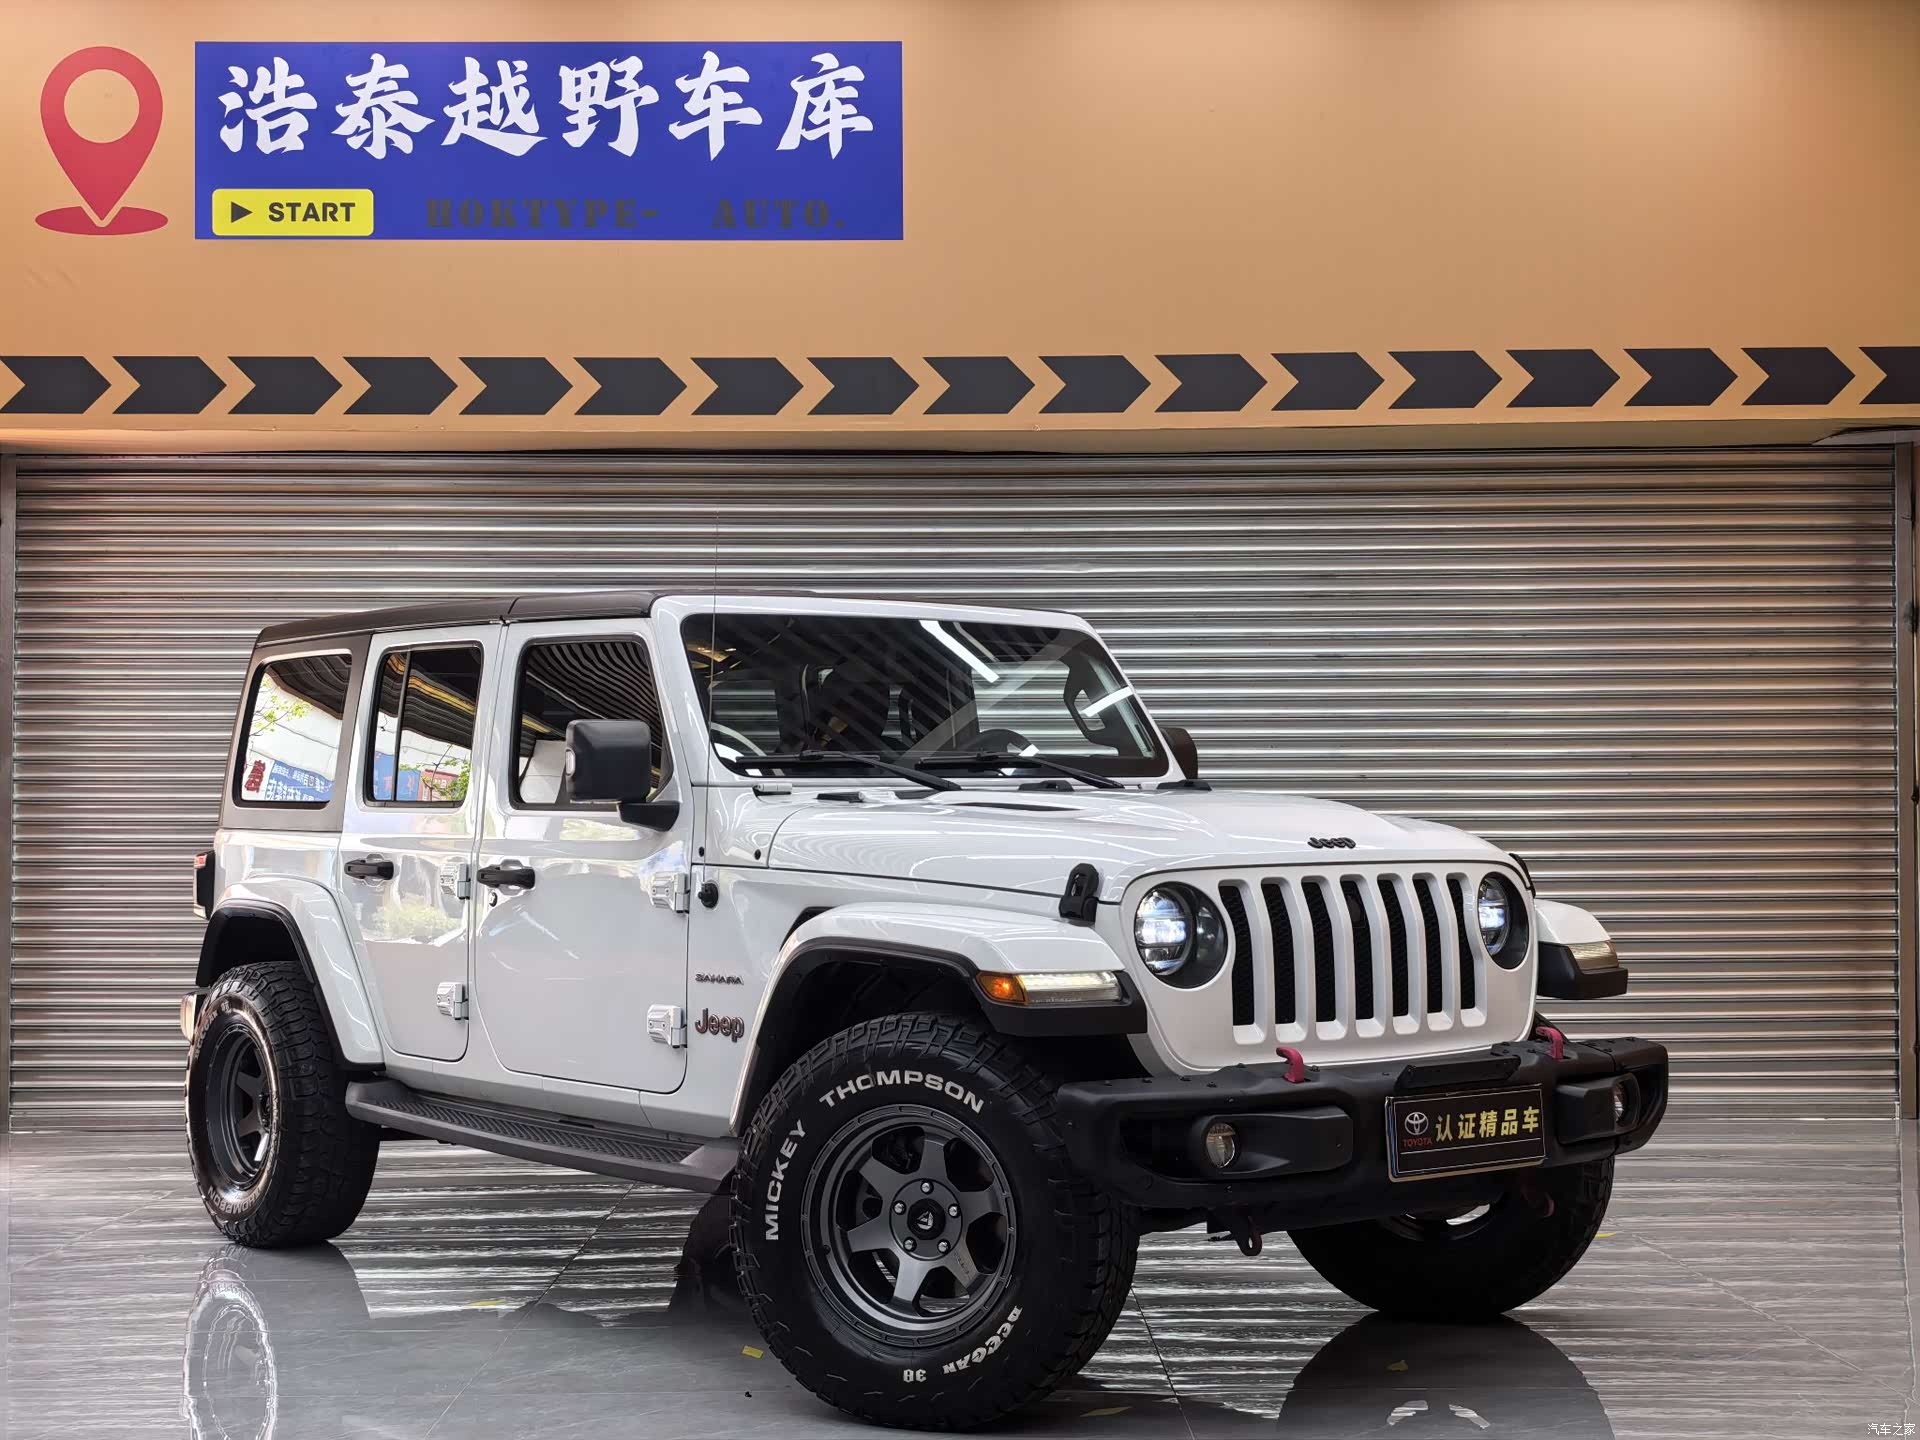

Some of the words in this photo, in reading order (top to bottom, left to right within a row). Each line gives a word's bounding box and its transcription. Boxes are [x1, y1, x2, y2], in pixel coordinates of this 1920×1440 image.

[217, 50, 874, 160] 浩泰越野车库
[267, 201, 356, 223] START
[711, 198, 847, 229] AUTO.
[695, 973, 744, 986] SAHARA
[694, 1008, 745, 1043] Jeep
[1435, 1105, 1540, 1142] 认证精品车
[764, 1119, 807, 1241] MICKEY
[818, 1069, 985, 1114] THOMPSON
[1403, 1136, 1433, 1149] TOYOTA
[902, 1368, 927, 1383] 38
